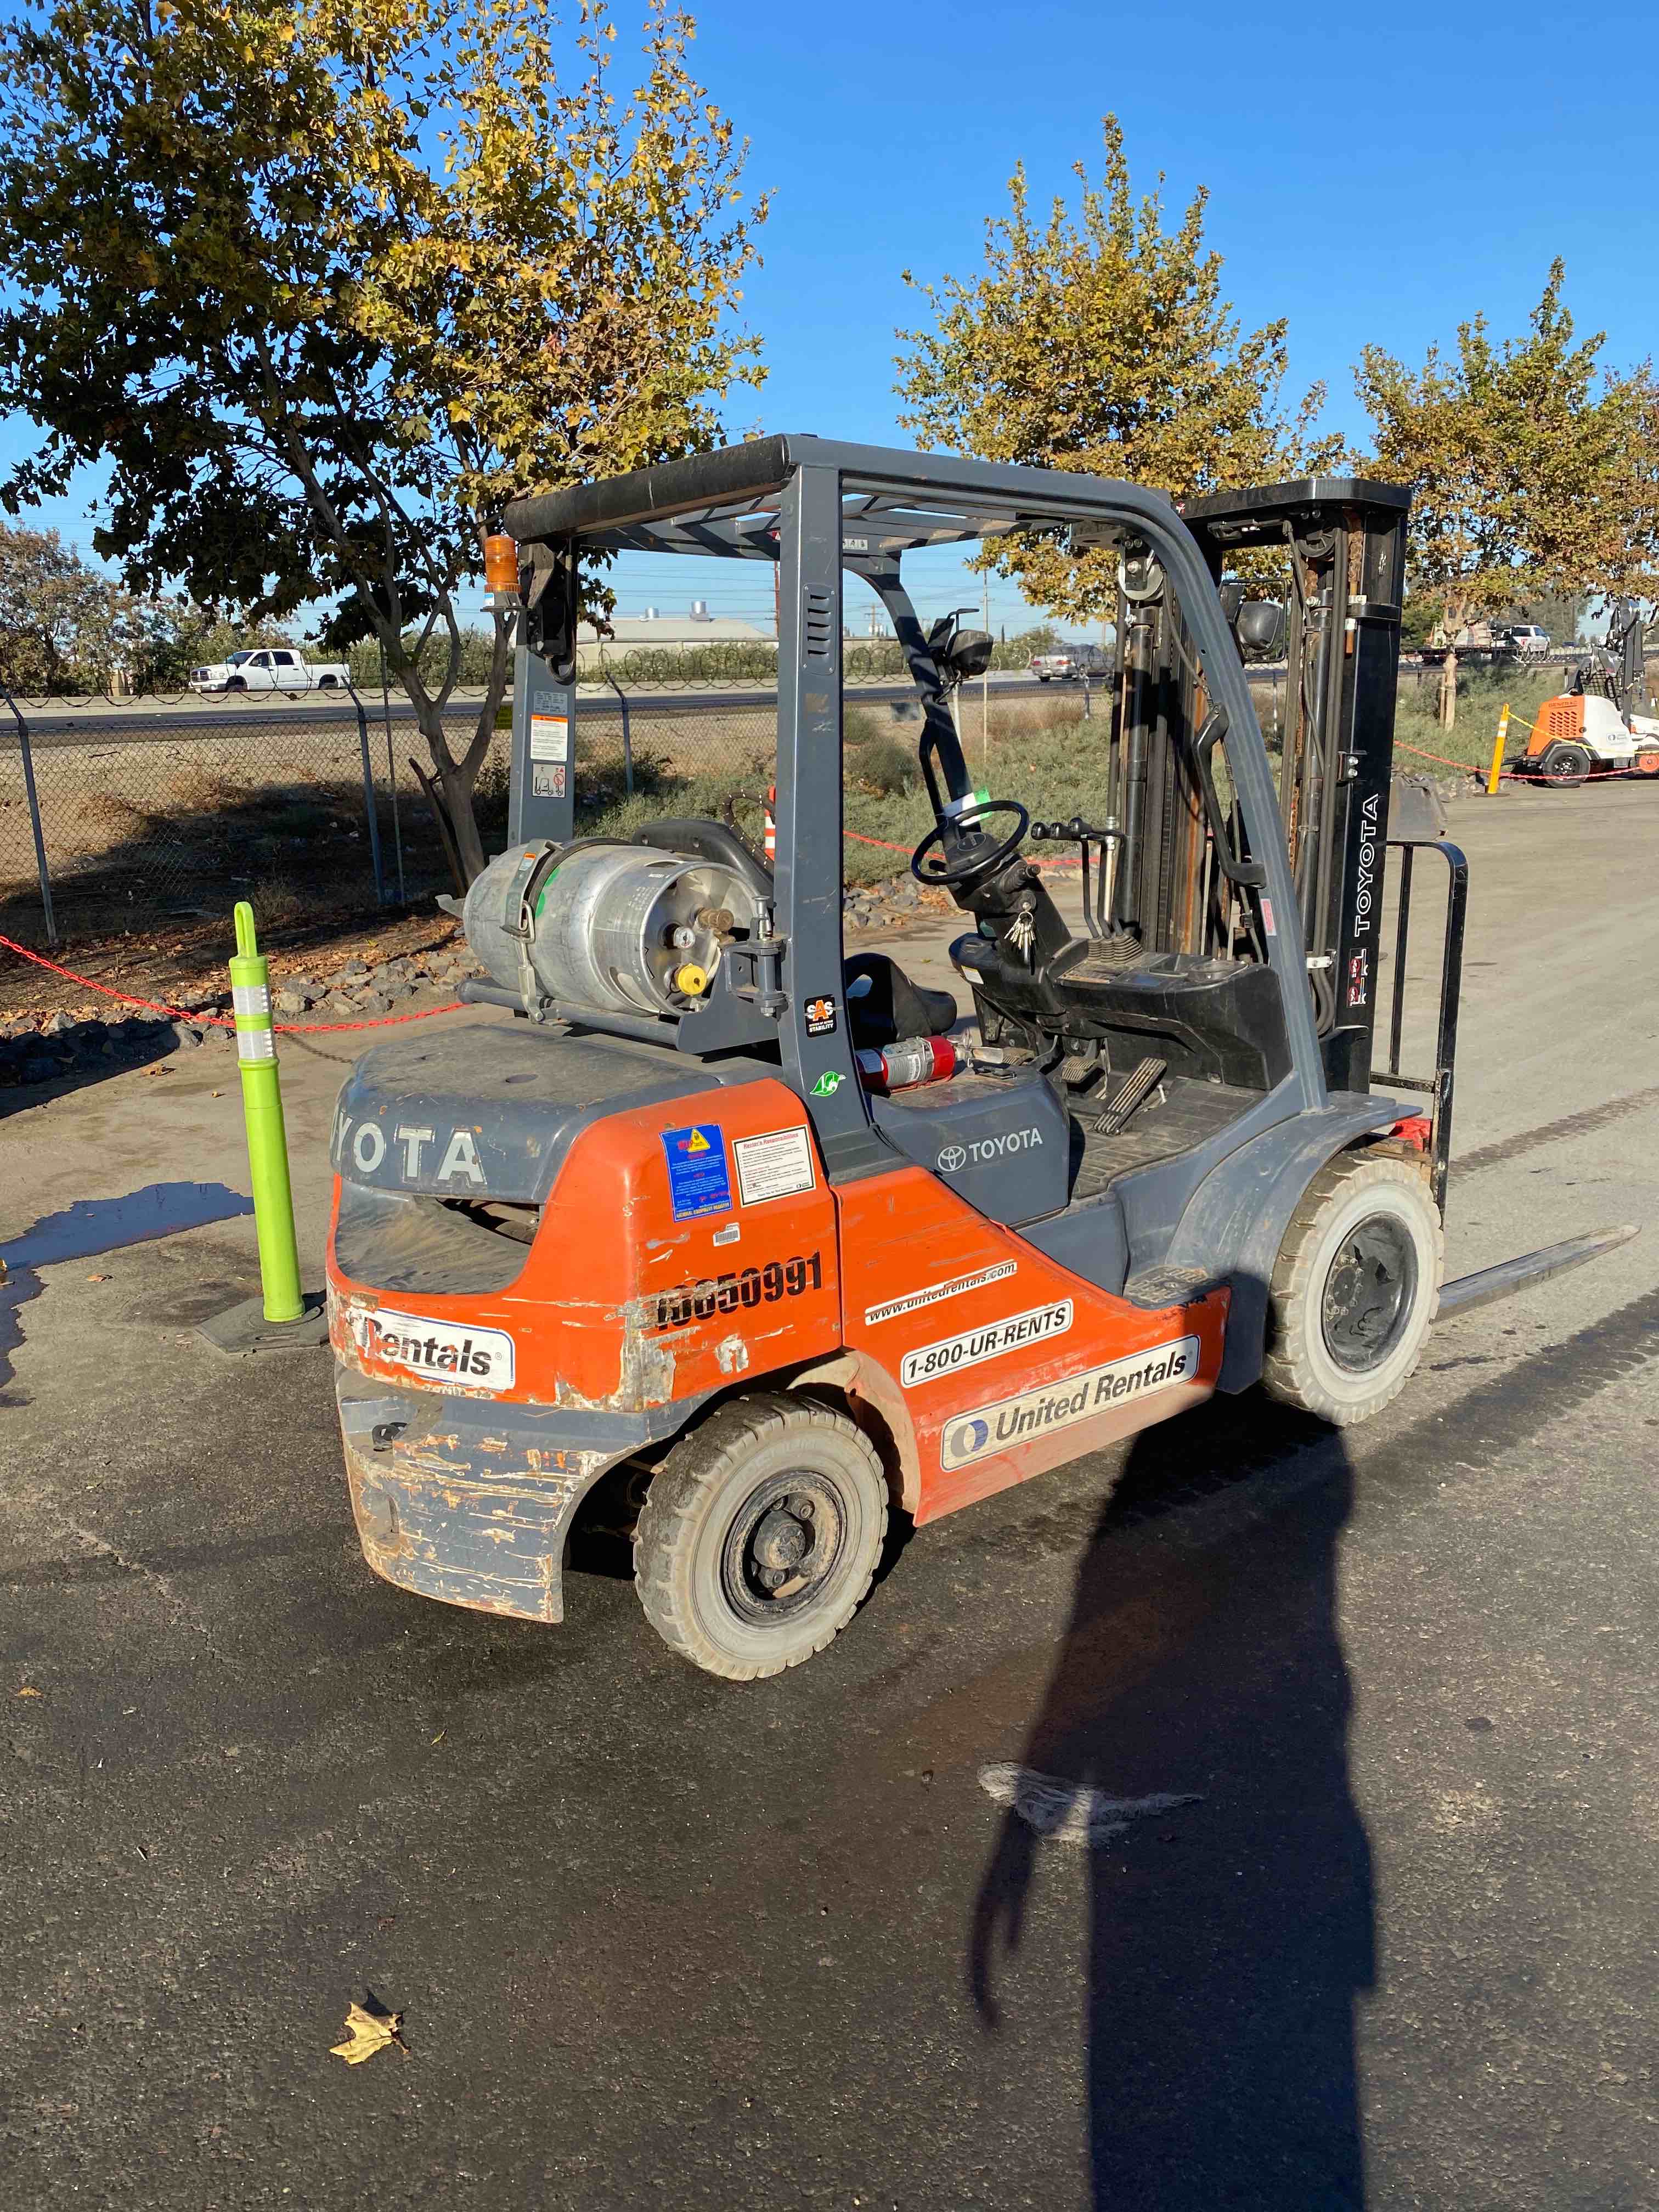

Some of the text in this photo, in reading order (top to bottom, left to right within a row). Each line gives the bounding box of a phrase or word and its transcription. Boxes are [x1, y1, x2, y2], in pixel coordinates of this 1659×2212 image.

[1355, 793, 1379, 938] TOYOTA
[807, 1000, 833, 1021] SAS
[809, 1023, 833, 1032] STABILITY
[330, 1105, 487, 1183] YOTA
[969, 1127, 1043, 1162] TOYOTA
[908, 1306, 1066, 1379] 1-800-UR-RENTS
[996, 1351, 1186, 1441] United Rentals
